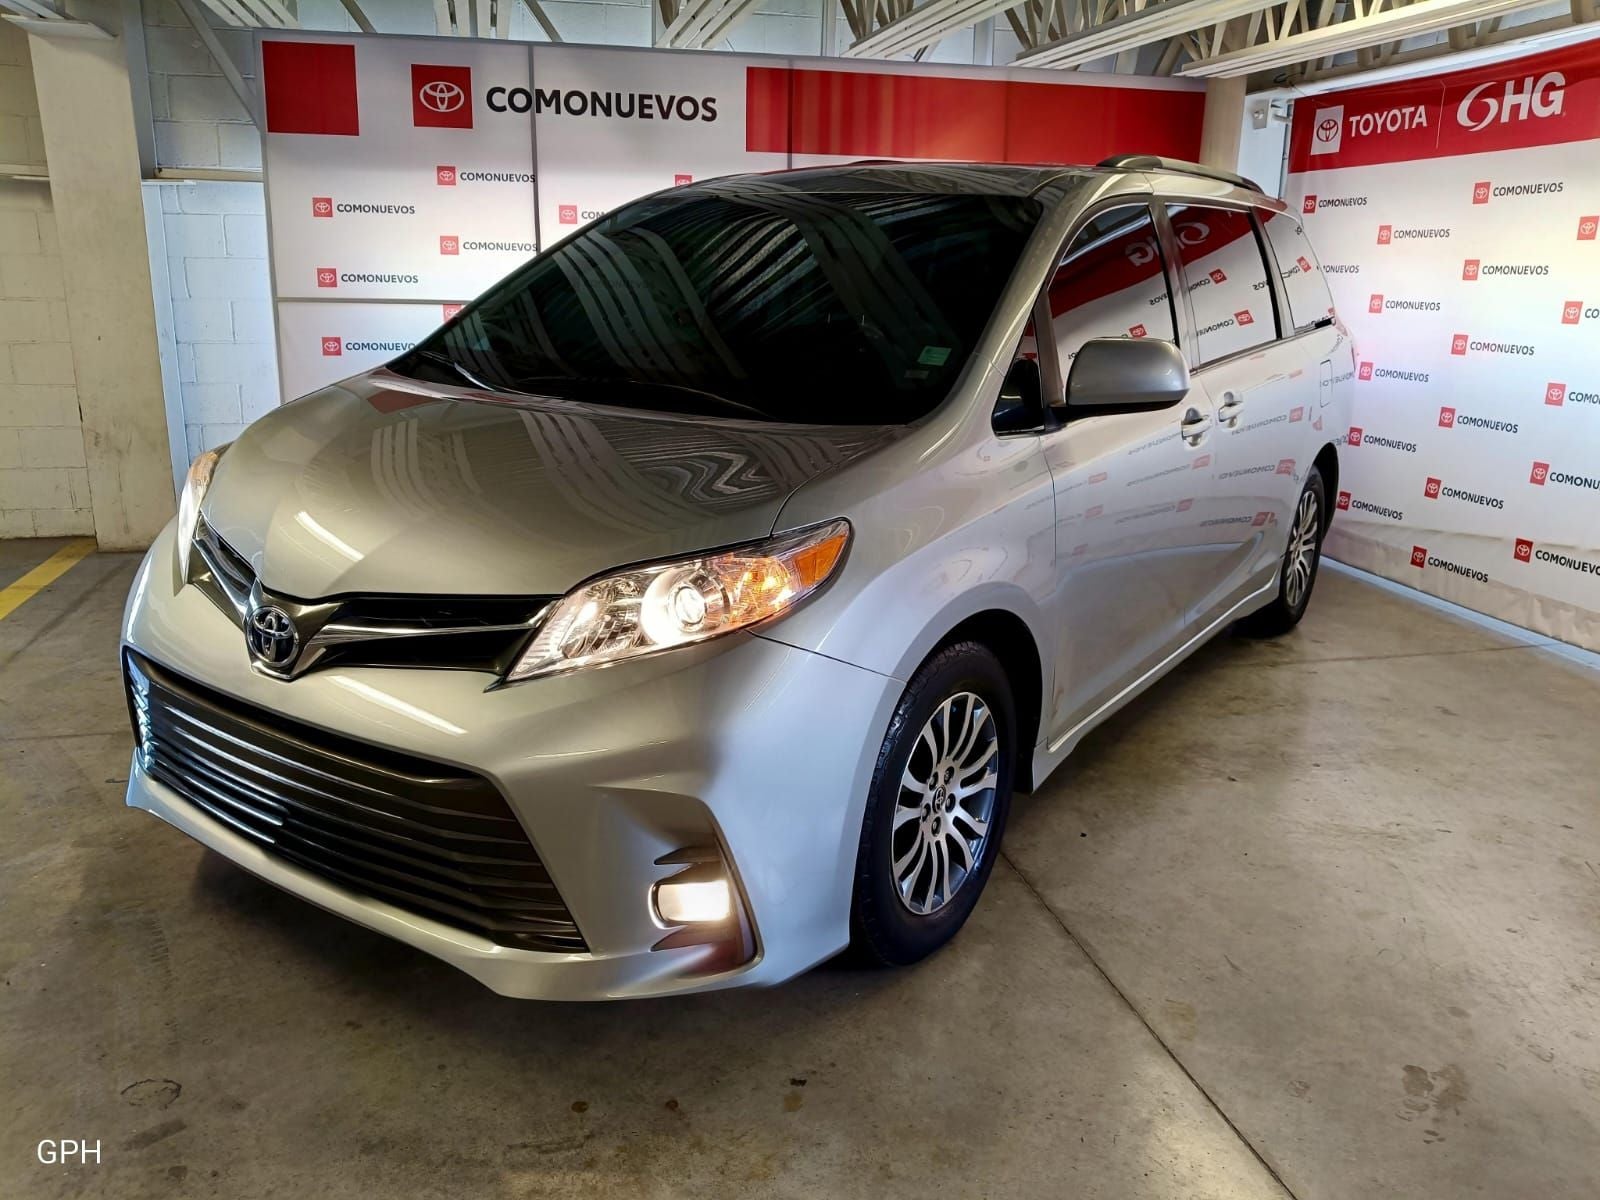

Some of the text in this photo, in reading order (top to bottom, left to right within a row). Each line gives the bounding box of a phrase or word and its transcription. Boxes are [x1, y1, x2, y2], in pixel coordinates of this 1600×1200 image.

[485, 86, 717, 122] COMONUEVOS
[1349, 105, 1427, 137] TOYOTA
[460, 172, 536, 183] COMONUEVOS
[1493, 182, 1563, 198] COMONUEVOS
[336, 203, 416, 214] COMONUEVOS
[1318, 196, 1368, 208] COMONUEVOS
[1393, 228, 1450, 239] COMONUEVOS
[463, 241, 538, 252] COMONUEVOS
[1482, 265, 1549, 275] COMONUEVOS
[341, 273, 419, 284] COMONUEVOS
[1385, 300, 1441, 311] COMONUEVOS
[1470, 341, 1535, 356] COMONUEVOS
[1374, 368, 1429, 383] COMONUEVOS
[1568, 391, 1600, 405] COMO
[1457, 415, 1519, 434] COMONUEVOS
[1363, 434, 1417, 453] COMONUEVOS
[1441, 486, 1505, 510] COMONUEVOS
[1351, 499, 1403, 521] COMONUEVOS
[1427, 556, 1489, 583] COMONUEVOS
